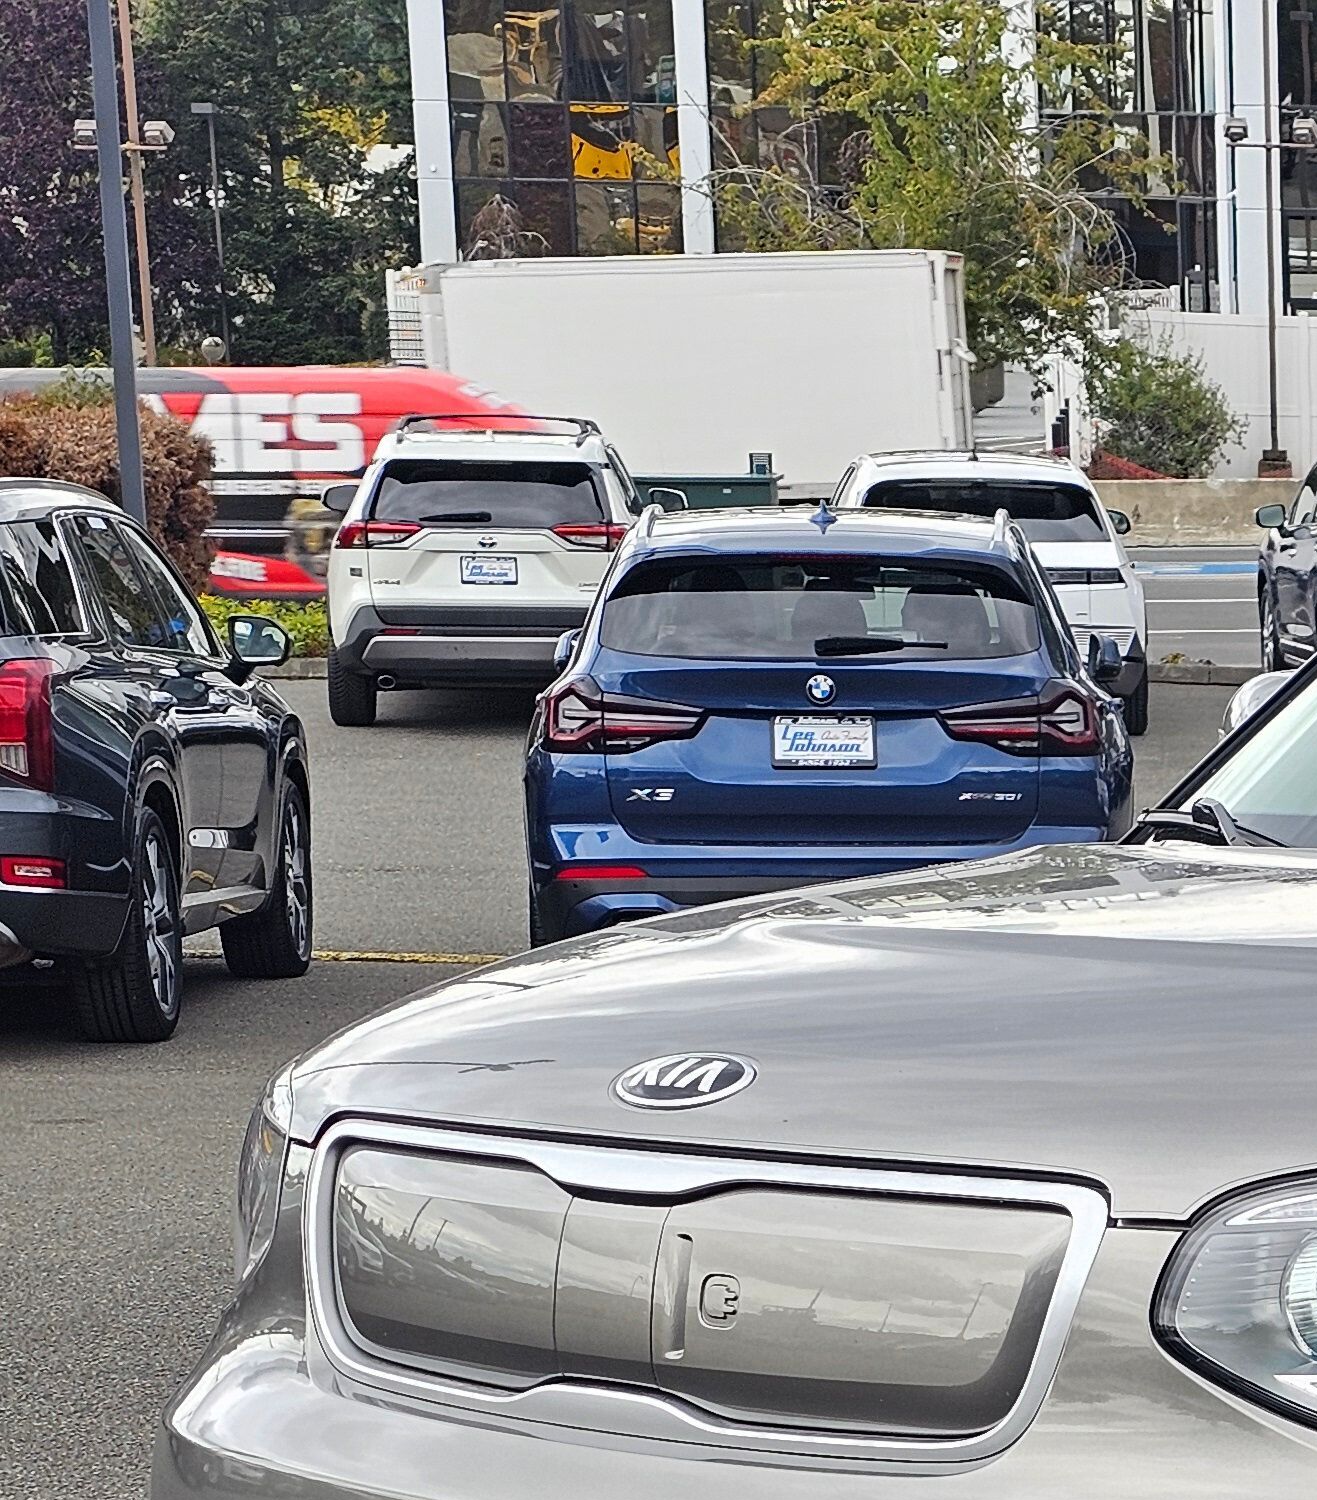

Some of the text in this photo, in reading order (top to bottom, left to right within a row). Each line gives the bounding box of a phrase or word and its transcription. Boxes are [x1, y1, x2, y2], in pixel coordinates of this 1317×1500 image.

[782, 726, 818, 740] Lee
[783, 737, 863, 752] Johnson
[626, 788, 675, 802] X3
[626, 1056, 731, 1093] KIA
